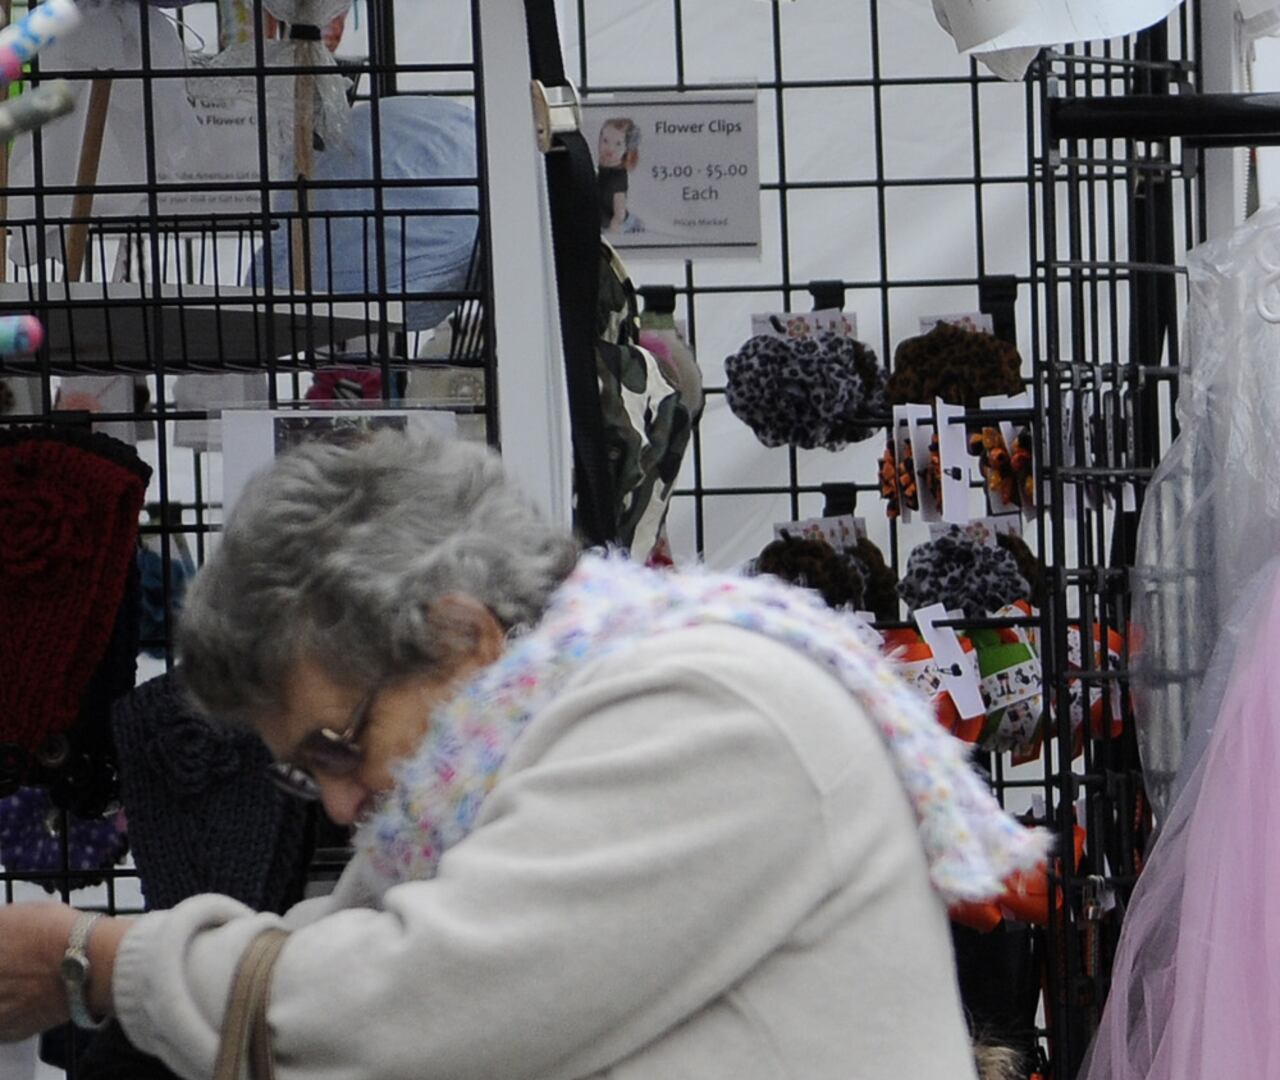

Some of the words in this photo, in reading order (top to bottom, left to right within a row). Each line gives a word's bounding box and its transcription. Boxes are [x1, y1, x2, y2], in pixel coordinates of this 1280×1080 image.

[655, 120, 704, 135] Flower
[708, 118, 742, 136] Clips
[651, 163, 693, 181] $3.00
[706, 162, 748, 180] $5.00
[682, 185, 719, 201] Each
